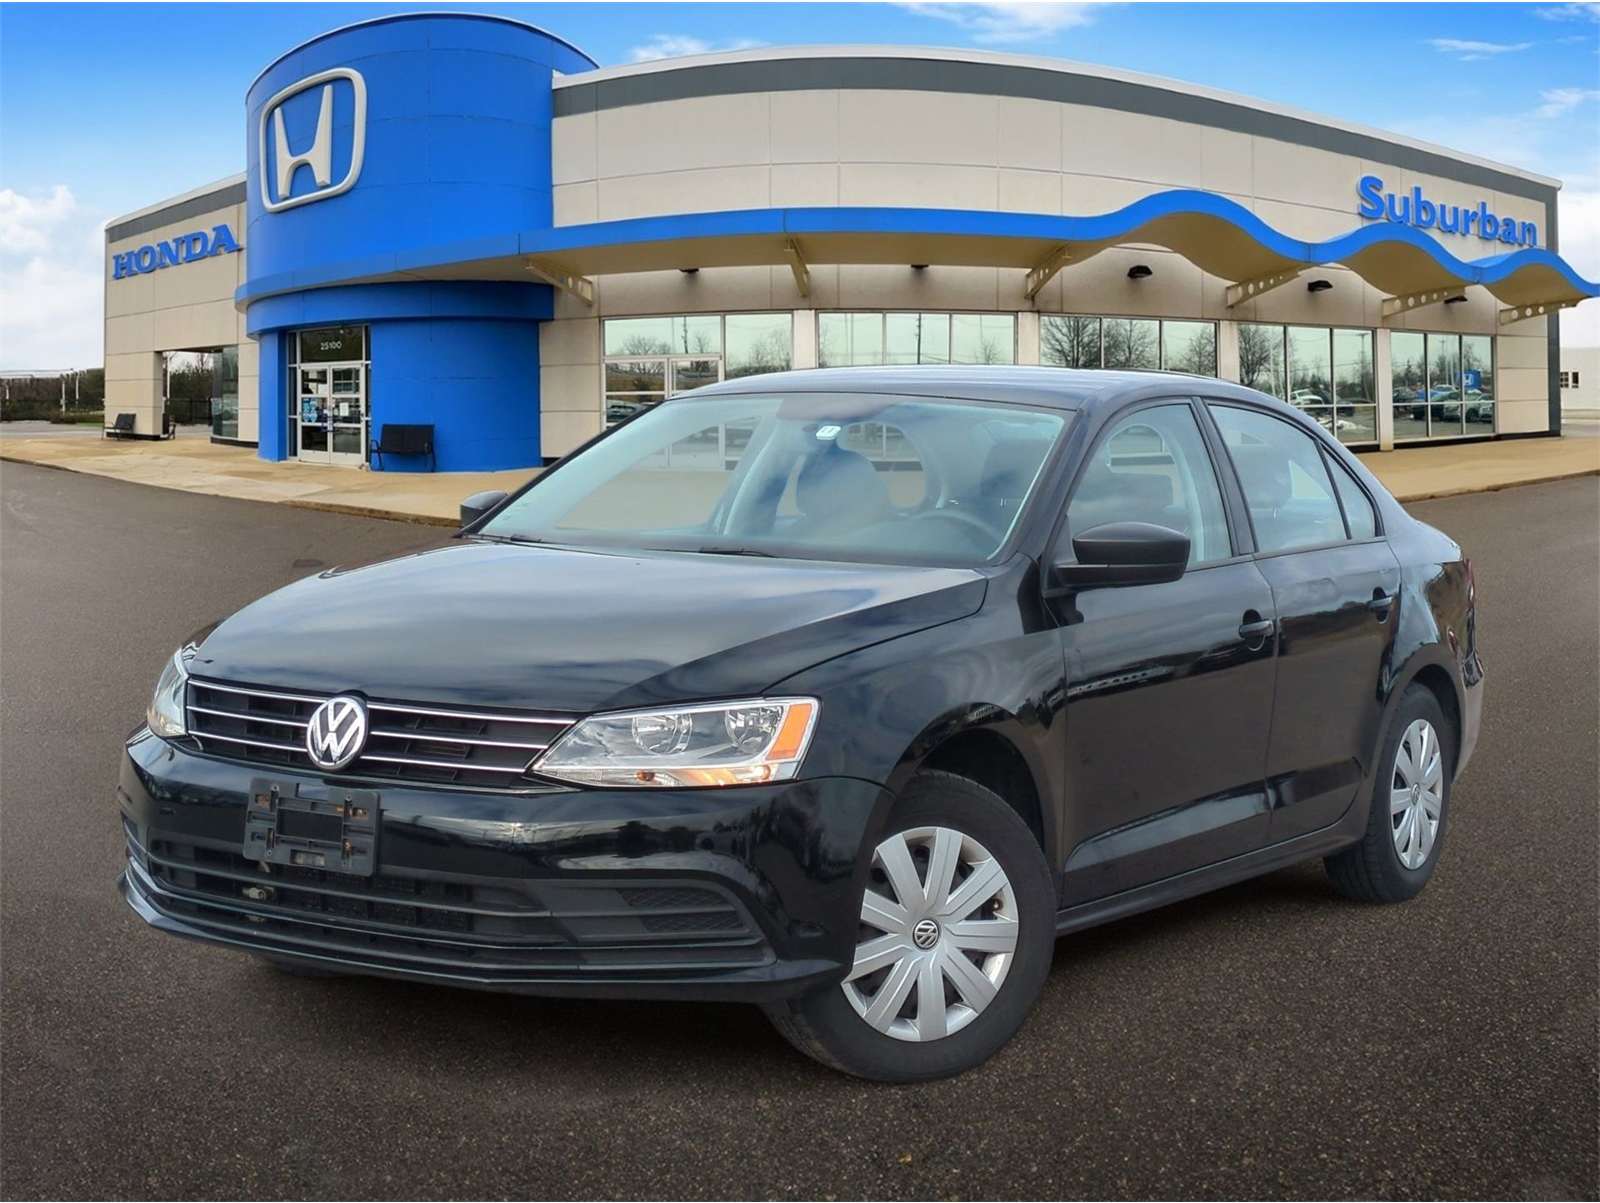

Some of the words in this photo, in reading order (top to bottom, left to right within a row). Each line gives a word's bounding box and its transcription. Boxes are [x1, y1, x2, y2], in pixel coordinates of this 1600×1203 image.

[1358, 175, 1538, 248] Suburban
[112, 223, 242, 280] HONDA
[320, 340, 342, 350] 25100
[307, 697, 366, 769] VW
